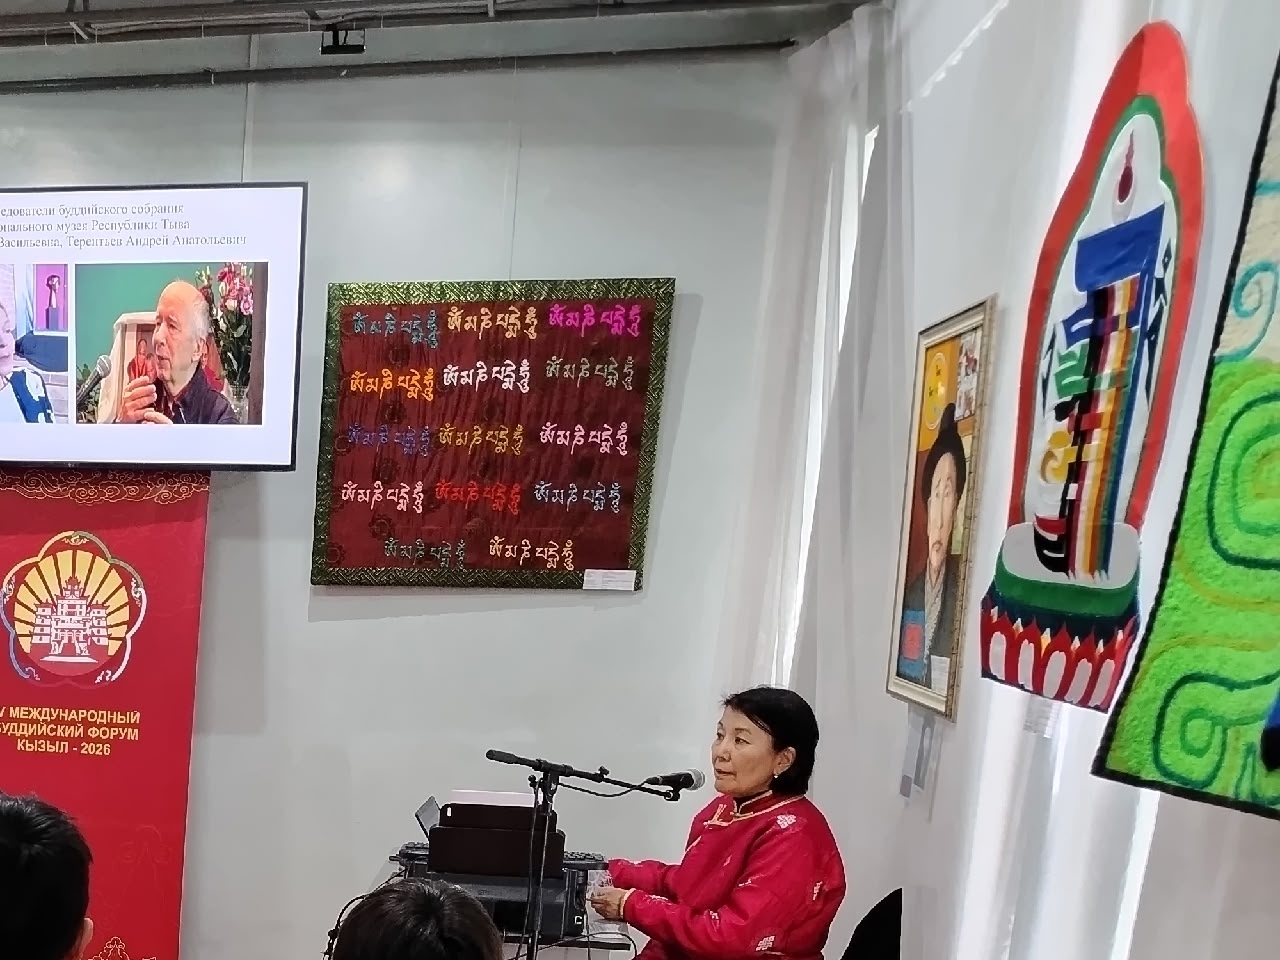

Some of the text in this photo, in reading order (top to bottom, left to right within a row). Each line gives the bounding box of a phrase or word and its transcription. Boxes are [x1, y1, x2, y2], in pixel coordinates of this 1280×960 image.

[59, 204, 128, 218] буддийского
[131, 203, 184, 216] собрания
[56, 223, 88, 234] музея
[91, 219, 158, 233] Республики
[161, 218, 190, 230] Тыва
[66, 236, 123, 249] Терентьев
[126, 235, 169, 248] Андрей
[172, 234, 247, 246] Анатольевич
[9, 706, 141, 724] МЕЖДУНАРОДНЫЙ
[87, 726, 139, 741] ФОРУМ
[17, 738, 69, 754] КЫЗЫЛ
[80, 742, 111, 756] 2026
